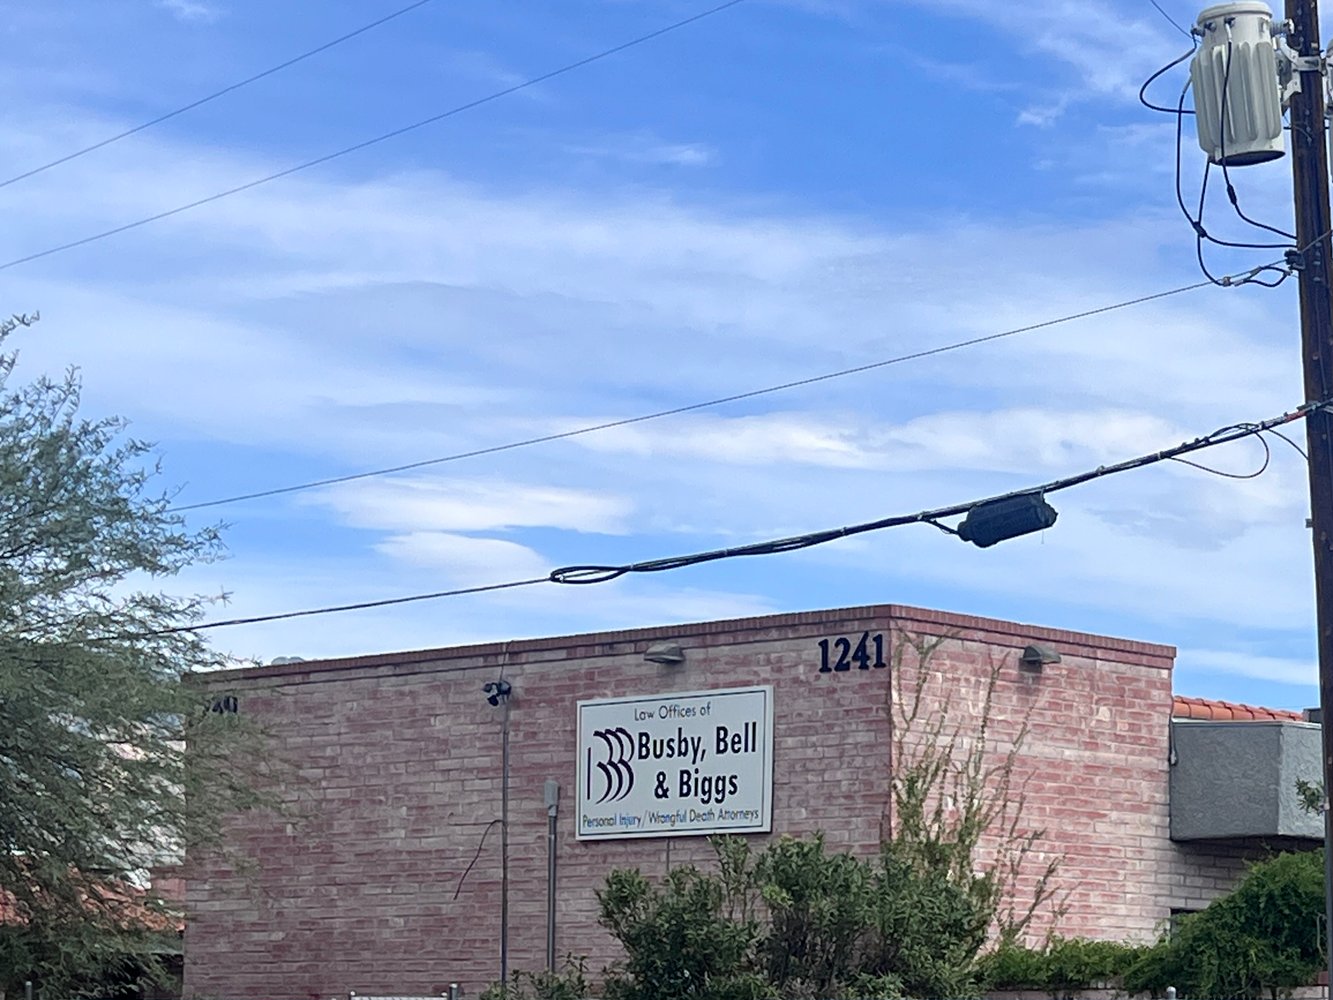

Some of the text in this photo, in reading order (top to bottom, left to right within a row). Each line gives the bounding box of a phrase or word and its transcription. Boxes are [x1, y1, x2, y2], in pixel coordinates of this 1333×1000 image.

[817, 631, 887, 673] 1241
[634, 701, 711, 722] Law Offices of
[637, 721, 757, 765] Busby, Bell
[654, 768, 739, 805] & Biggs
[582, 814, 617, 828] Personal
[689, 808, 715, 823] Death
[717, 808, 759, 823] Attorneys
